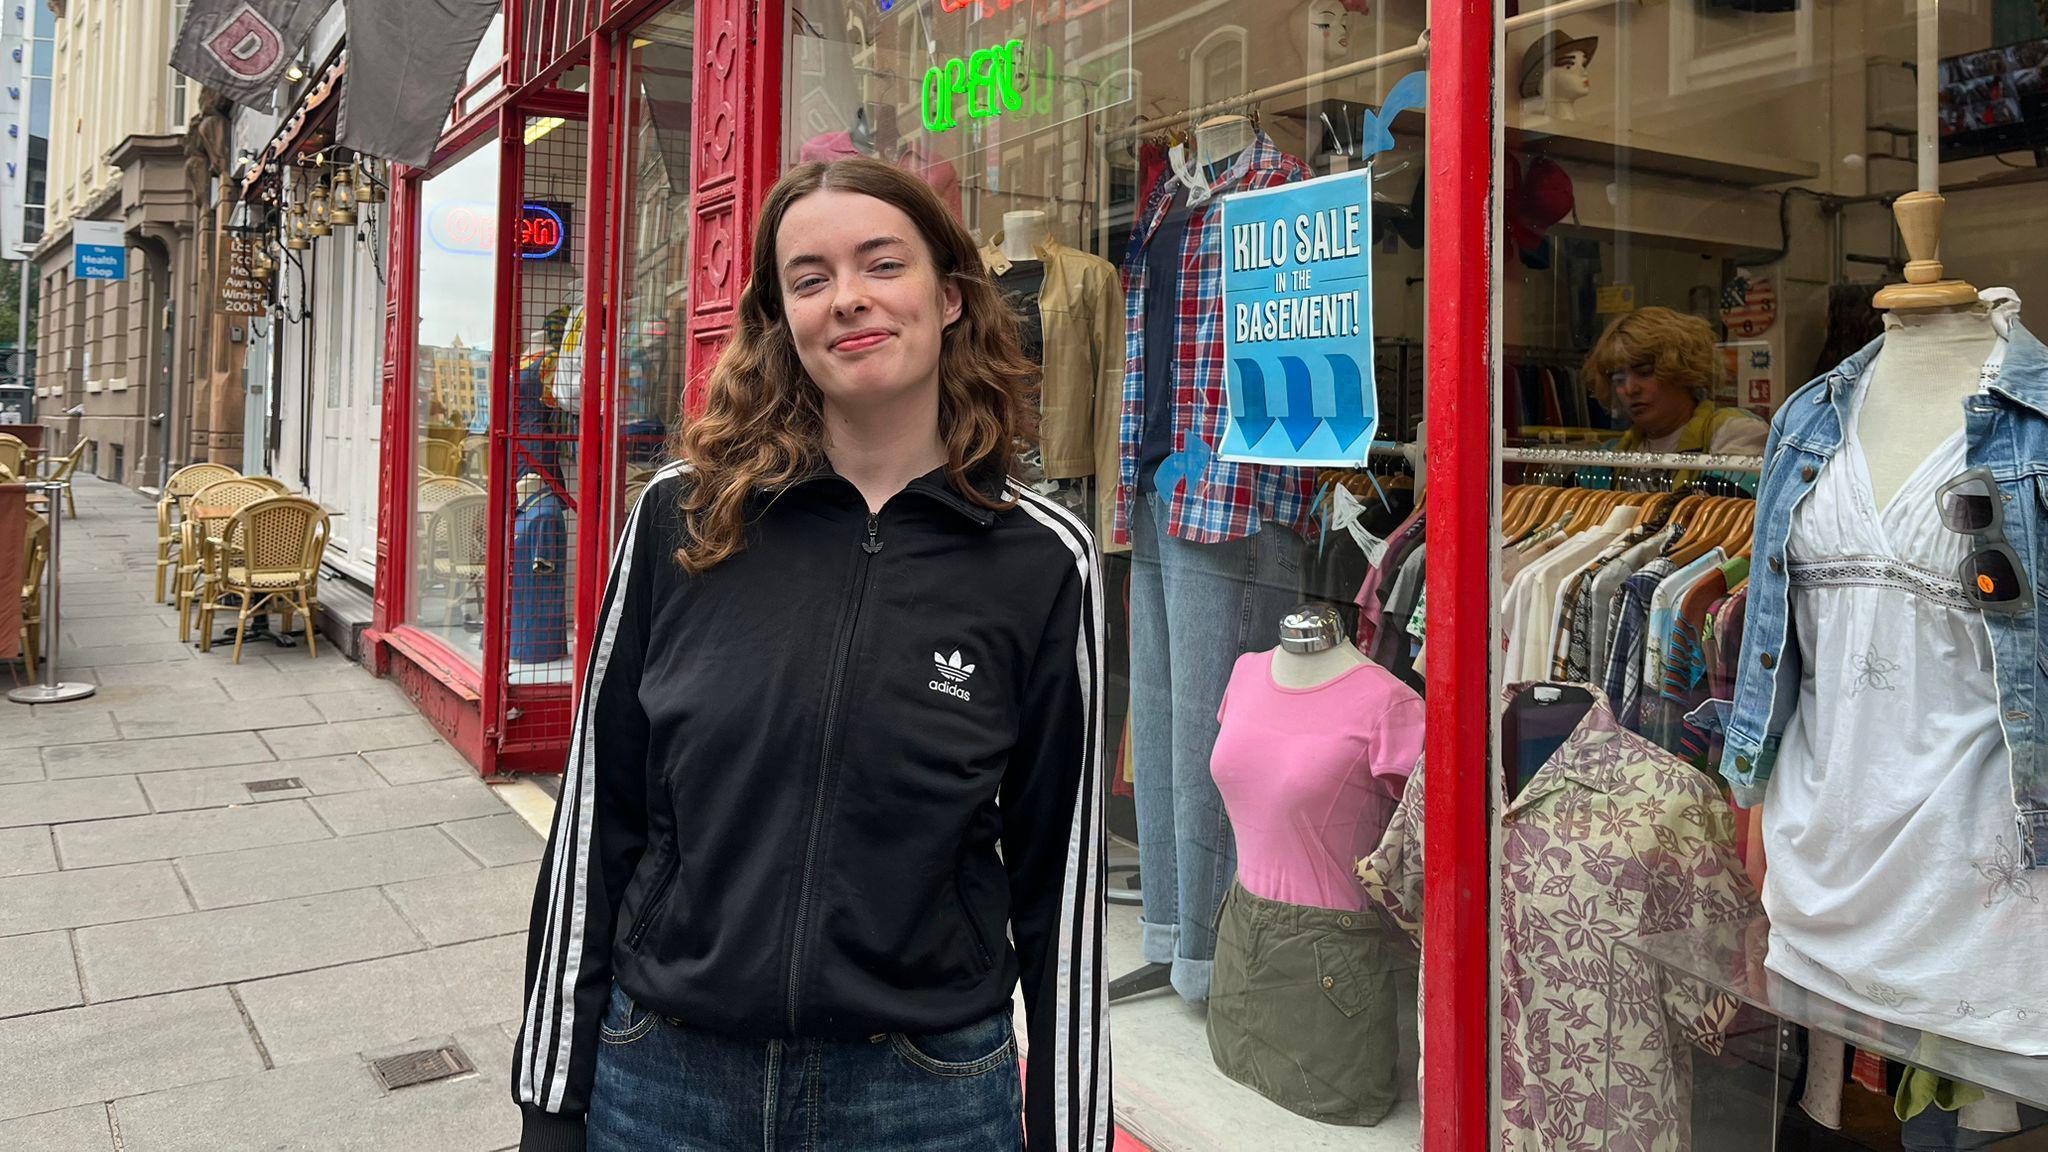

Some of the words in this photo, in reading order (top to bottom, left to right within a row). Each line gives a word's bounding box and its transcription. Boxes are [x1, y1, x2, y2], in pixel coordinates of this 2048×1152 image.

[201, 2, 284, 80] D
[922, 40, 1025, 132] OPEN
[1232, 218, 1288, 272] KILO
[1294, 204, 1361, 265] SALE
[82, 255, 118, 266] Health
[86, 266, 114, 278] Shop
[1275, 272, 1286, 293] IN
[1291, 269, 1312, 292] THE
[1235, 290, 1360, 344] BASEMENT!
[928, 680, 971, 702] adidas
